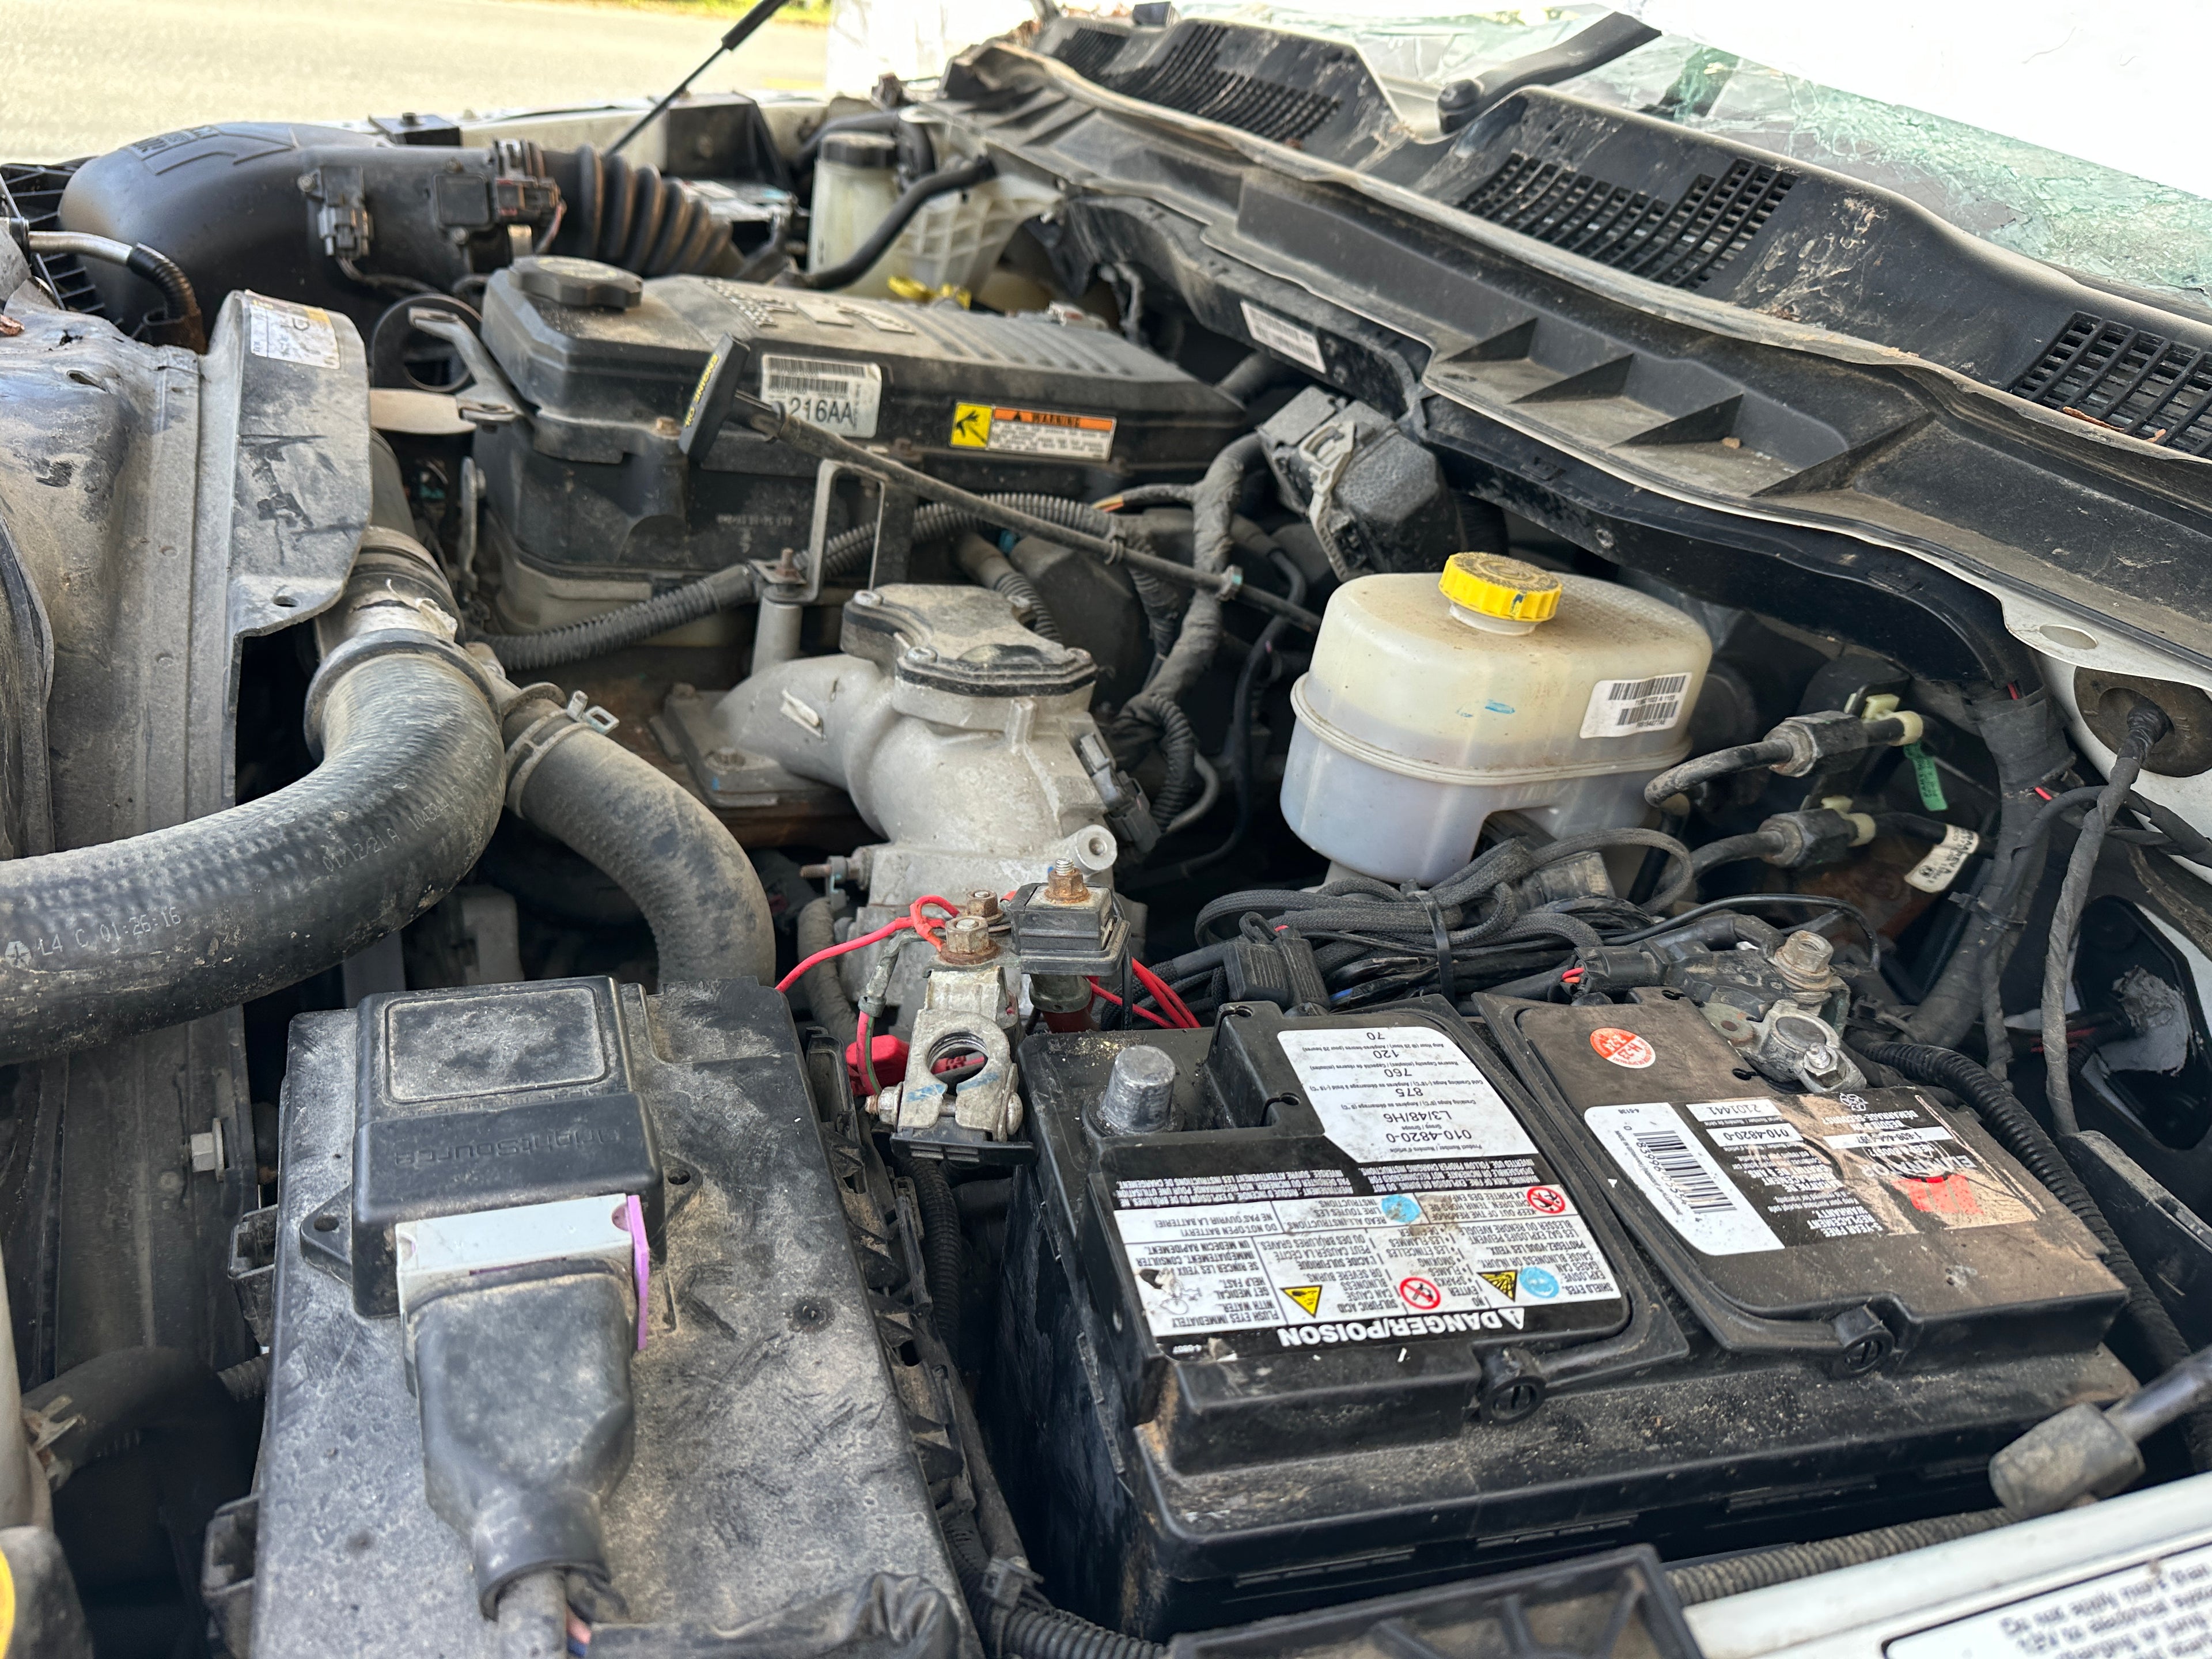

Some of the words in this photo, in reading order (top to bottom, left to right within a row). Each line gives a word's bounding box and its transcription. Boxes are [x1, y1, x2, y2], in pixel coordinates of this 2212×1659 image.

[693, 354, 718, 403] ENGINE
[1366, 1032, 1385, 1040] 70
[1372, 1050, 1399, 1058] 120
[1383, 1068, 1412, 1077] 760
[1395, 1087, 1423, 1096] 875
[1706, 1104, 1761, 1115] 2101441
[1382, 1110, 1452, 1122] L3/48/H6
[1819, 1110, 1918, 1126] DÉMARRAGE-SECOURS?
[1849, 1122, 1874, 1130] D'UN
[1870, 1120, 1904, 1128] BESOIN
[1385, 1129, 1472, 1142] 010-4820-0
[1722, 1128, 1789, 1141] 010-4820-0
[1868, 1146, 1902, 1156] BOOST?
[1899, 1146, 1910, 1154] A
[1908, 1143, 1934, 1153] NEED
[1789, 1164, 1829, 1175] GRATUIT
[1856, 1155, 1975, 1177] ELIMINATOR
[1743, 1169, 1768, 1178] ANS.
[1774, 1167, 1791, 1176] DE
[1762, 1172, 1836, 1185] REMPLACEMENT
[1781, 1183, 1798, 1192] DE
[1795, 1179, 1844, 1191] GARANTIE
[1467, 1193, 1484, 1201] DES
[1315, 1198, 1376, 1208] INSTRUCTIONS.
[1464, 1202, 1488, 1210] TENIR
[1313, 1209, 1330, 1217] LES
[1330, 1207, 1362, 1217] TOUTES
[1362, 1206, 1381, 1214] LIRE
[1469, 1210, 1487, 1218] THE
[1499, 1209, 1514, 1217] OUT
[1516, 1207, 1536, 1215] KEEP
[1811, 1206, 1868, 1218] WARRANTY.
[1196, 1217, 1209, 1225] LA
[1209, 1215, 1243, 1224] OUVRIR
[1243, 1214, 1260, 1222] PAS
[1260, 1213, 1272, 1221] NE
[1363, 1216, 1387, 1224] READ
[1806, 1214, 1875, 1229] REPLACEMENT
[1154, 1218, 1196, 1228] BATTERIE!
[1245, 1224, 1263, 1232] NOT
[1264, 1223, 1278, 1231] DO
[1286, 1218, 1347, 1230] INSTRUCTIONS.
[1493, 1223, 1526, 1233] RENDRE
[1524, 1222, 1538, 1231] OU
[1537, 1219, 1573, 1230] BLESSER
[1845, 1222, 1883, 1234] 5-YEAR
[1181, 1227, 1221, 1237] BATTERY!
[1222, 1225, 1246, 1234] OPEN
[1546, 1229, 1563, 1238] GAZ
[1562, 1228, 1579, 1237] LES
[1820, 1226, 1848, 1237] FREE
[1335, 1235, 1353, 1245] DES
[1352, 1234, 1365, 1243] OU
[1428, 1235, 1445, 1244] LES
[1468, 1234, 1505, 1244] PEUVENT
[1503, 1230, 1547, 1242] EXPLOSIFS
[1237, 1240, 1250, 1248] UN
[1260, 1239, 1293, 1250] GRAVES.
[1388, 1236, 1429, 1247] FLAMMES
[1525, 1240, 1586, 1253] PROTÉGEZ-VOUS
[1147, 1243, 1199, 1255] RAPIDEMENT.
[1302, 1249, 1315, 1257] LA
[1315, 1247, 1349, 1257] CAUSER
[1349, 1245, 1371, 1255] PEUT
[1385, 1246, 1434, 1258] ÉTINCELLES
[1433, 1245, 1450, 1254] LES
[1486, 1245, 1510, 1255] YEUX.
[1510, 1244, 1526, 1253] LES
[1136, 1255, 1183, 1267] CONSULTER
[1345, 1255, 1377, 1266] L'ACIDE
[1416, 1256, 1456, 1267] SMOKING
[1509, 1257, 1523, 1266] OR
[1522, 1253, 1567, 1265] BLINDNESS
[1566, 1251, 1593, 1262] CAUSE
[1216, 1263, 1247, 1272] RINCER
[1247, 1261, 1259, 1270] SE
[1296, 1258, 1346, 1270] SULFURIQUE
[1478, 1258, 1510, 1268] INJURY.
[1555, 1263, 1573, 1272] CAN
[1572, 1261, 1599, 1271] GASES
[1176, 1266, 1199, 1275] YEUX
[1200, 1264, 1215, 1274] LES
[1369, 1268, 1382, 1278] OR
[1427, 1266, 1461, 1276] FLAMES
[1303, 1271, 1336, 1282] BURNS.
[1336, 1269, 1369, 1280] SEVERE
[1561, 1270, 1606, 1282] EXPLOSIVE
[1219, 1278, 1243, 1288] FAST.
[1245, 1277, 1266, 1286] HELP
[1340, 1278, 1388, 1290] BLINDNESS
[1433, 1275, 1467, 1286] SPARKS
[1253, 1286, 1270, 1296] GET
[1561, 1284, 1586, 1295] EYES.
[1585, 1282, 1613, 1293] SHIELD
[1214, 1288, 1252, 1299] MEDICAL
[1344, 1290, 1374, 1301] CAUSE
[1374, 1288, 1393, 1298] CAN
[1252, 1300, 1275, 1309] WITH
[1336, 1302, 1357, 1312] ACID
[1358, 1299, 1398, 1310] SULFURIC
[1229, 1312, 1251, 1323] EYES
[1252, 1310, 1279, 1321] FLUSH
[1172, 1315, 1228, 1327] IMMEDIATELY
[1278, 1312, 1501, 1345] DANGER/POISON
